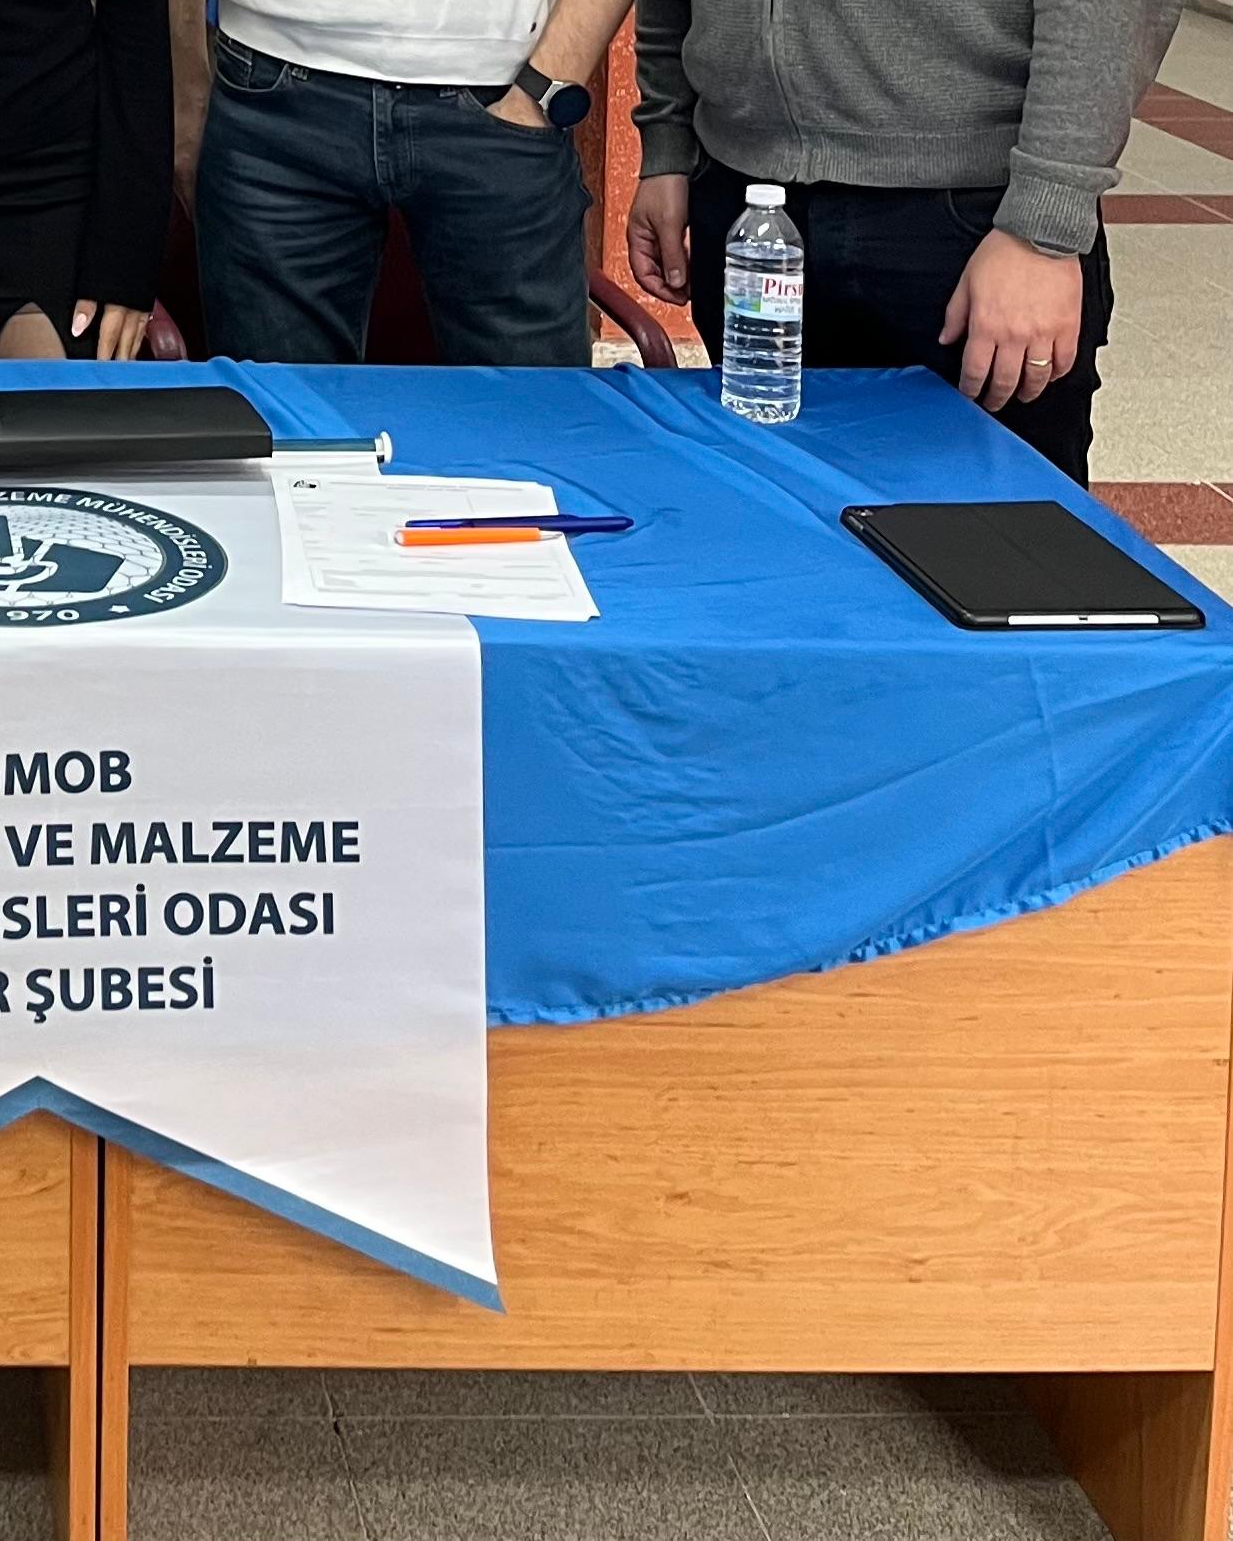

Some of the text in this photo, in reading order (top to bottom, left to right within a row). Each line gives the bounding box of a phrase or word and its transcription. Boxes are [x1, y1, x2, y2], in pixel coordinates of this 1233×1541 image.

[143, 568, 204, 604] ODASI
[5, 823, 75, 868] VE
[91, 821, 361, 865] MALZEME
[163, 892, 334, 936] ODASI
[26, 955, 214, 1024] ŞUBESİ
